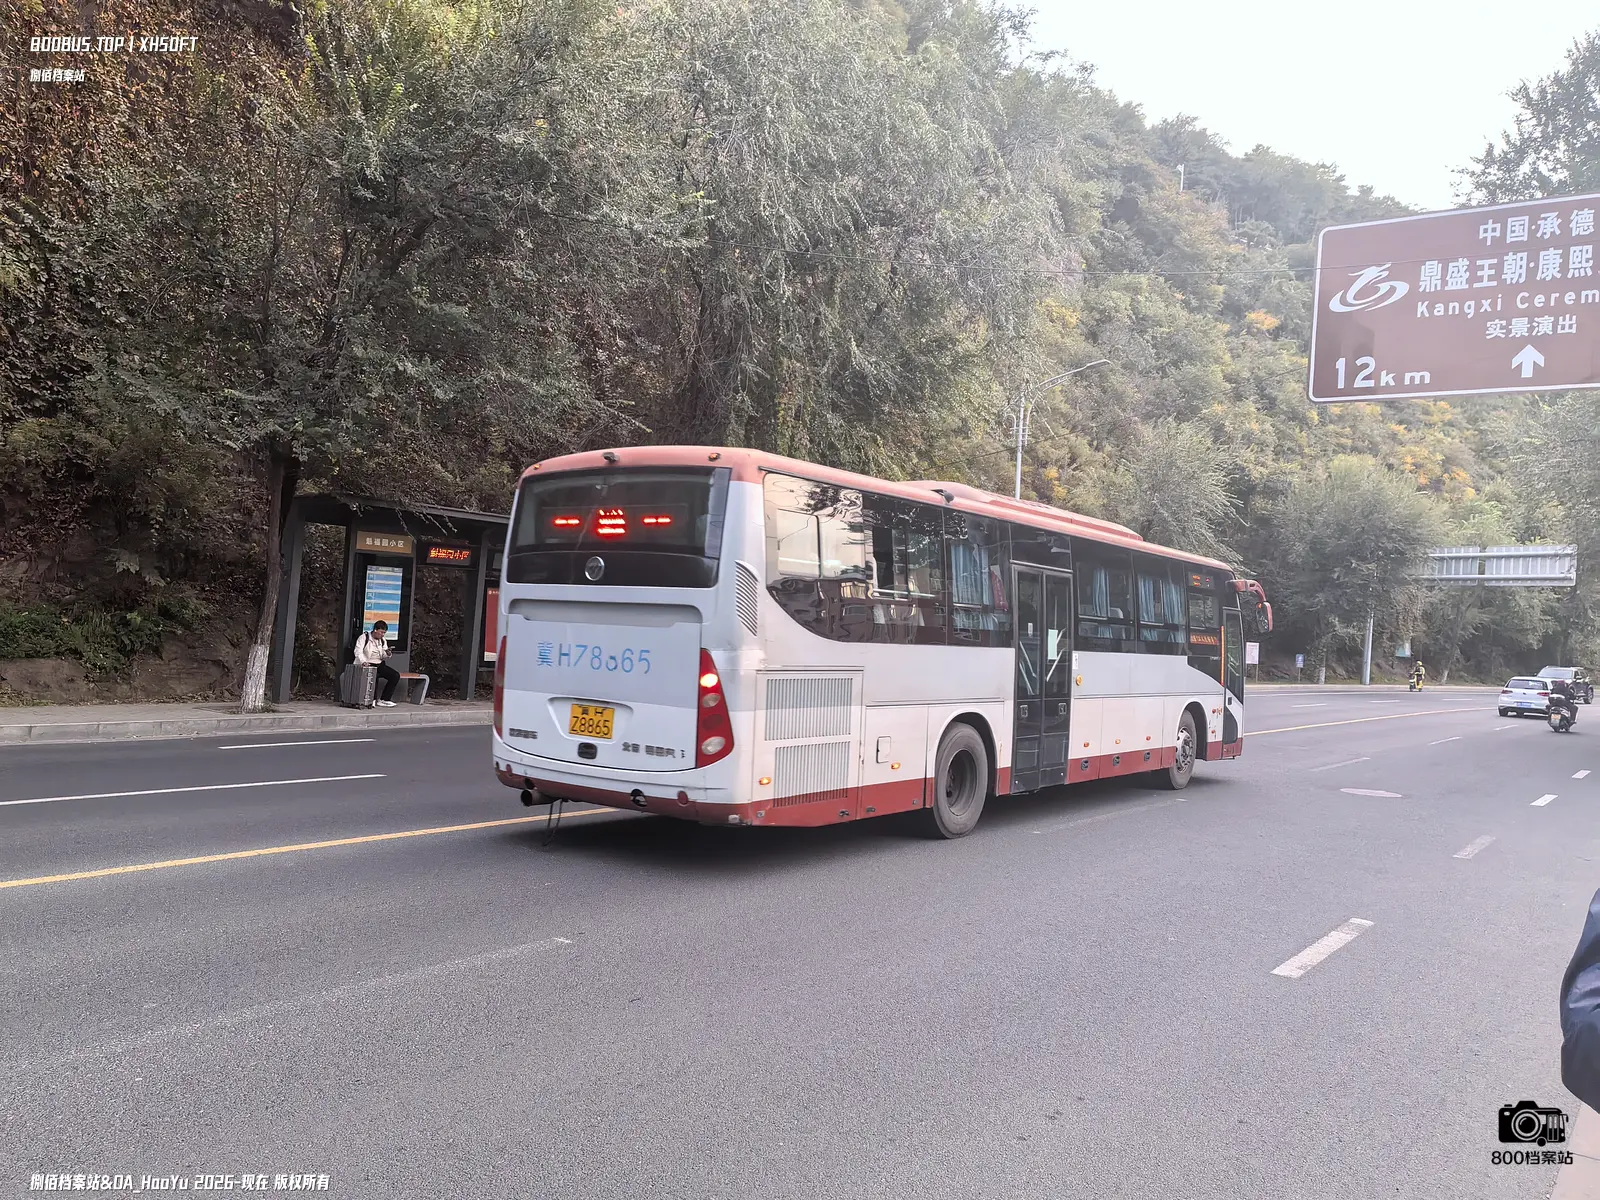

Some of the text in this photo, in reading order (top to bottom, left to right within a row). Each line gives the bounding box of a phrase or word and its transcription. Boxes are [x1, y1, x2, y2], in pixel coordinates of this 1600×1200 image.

[1419, 244, 1600, 293] 鼎盛王朝·康熙
[1416, 294, 1503, 319] Kangxi
[1485, 314, 1578, 340] 实景演出
[570, 715, 611, 736] Z8865
